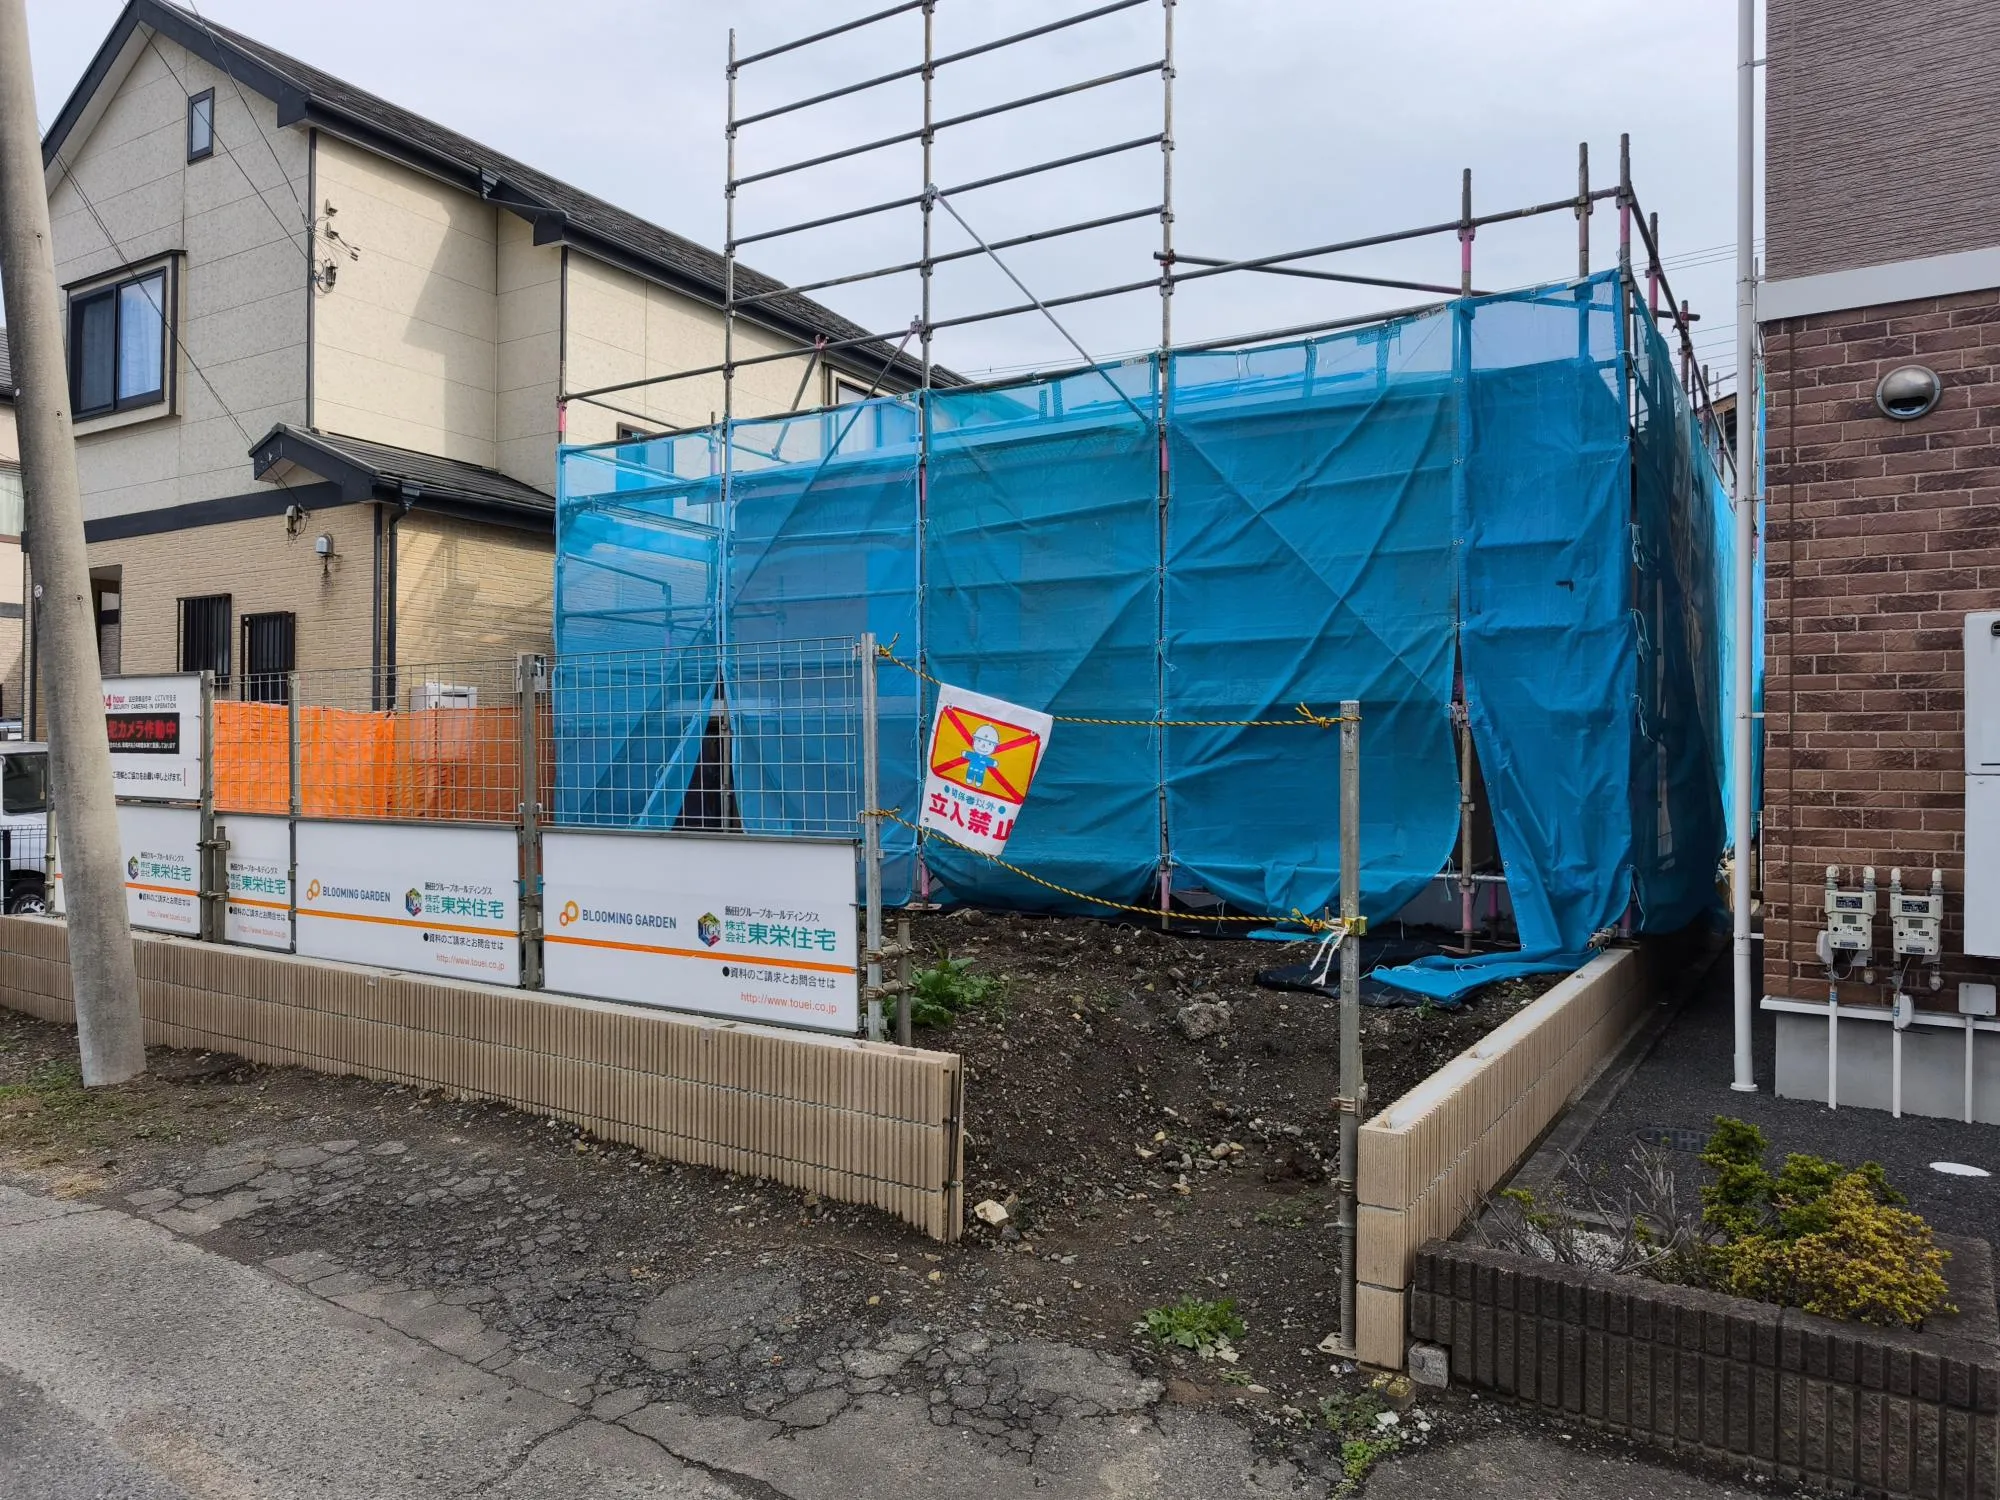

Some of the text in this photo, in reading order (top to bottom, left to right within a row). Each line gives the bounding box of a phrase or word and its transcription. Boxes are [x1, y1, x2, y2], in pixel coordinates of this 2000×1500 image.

[929, 793, 1013, 840] 立入禁止
[151, 863, 192, 881] 東栄住宅
[241, 875, 286, 895] 東栄住宅
[322, 886, 391, 903] BLOOMING GARDEN
[441, 896, 504, 919] 東栄住宅
[724, 905, 820, 923] 飯田グループホールディングス
[582, 909, 677, 930] BLOOMING GARDEN
[724, 919, 837, 951] 株式 東栄住宅
[725, 932, 746, 944] 会社
[730, 967, 836, 989] 資料のご請求とお問合せは
[740, 992, 837, 1014] http://www.touei.co.jp
